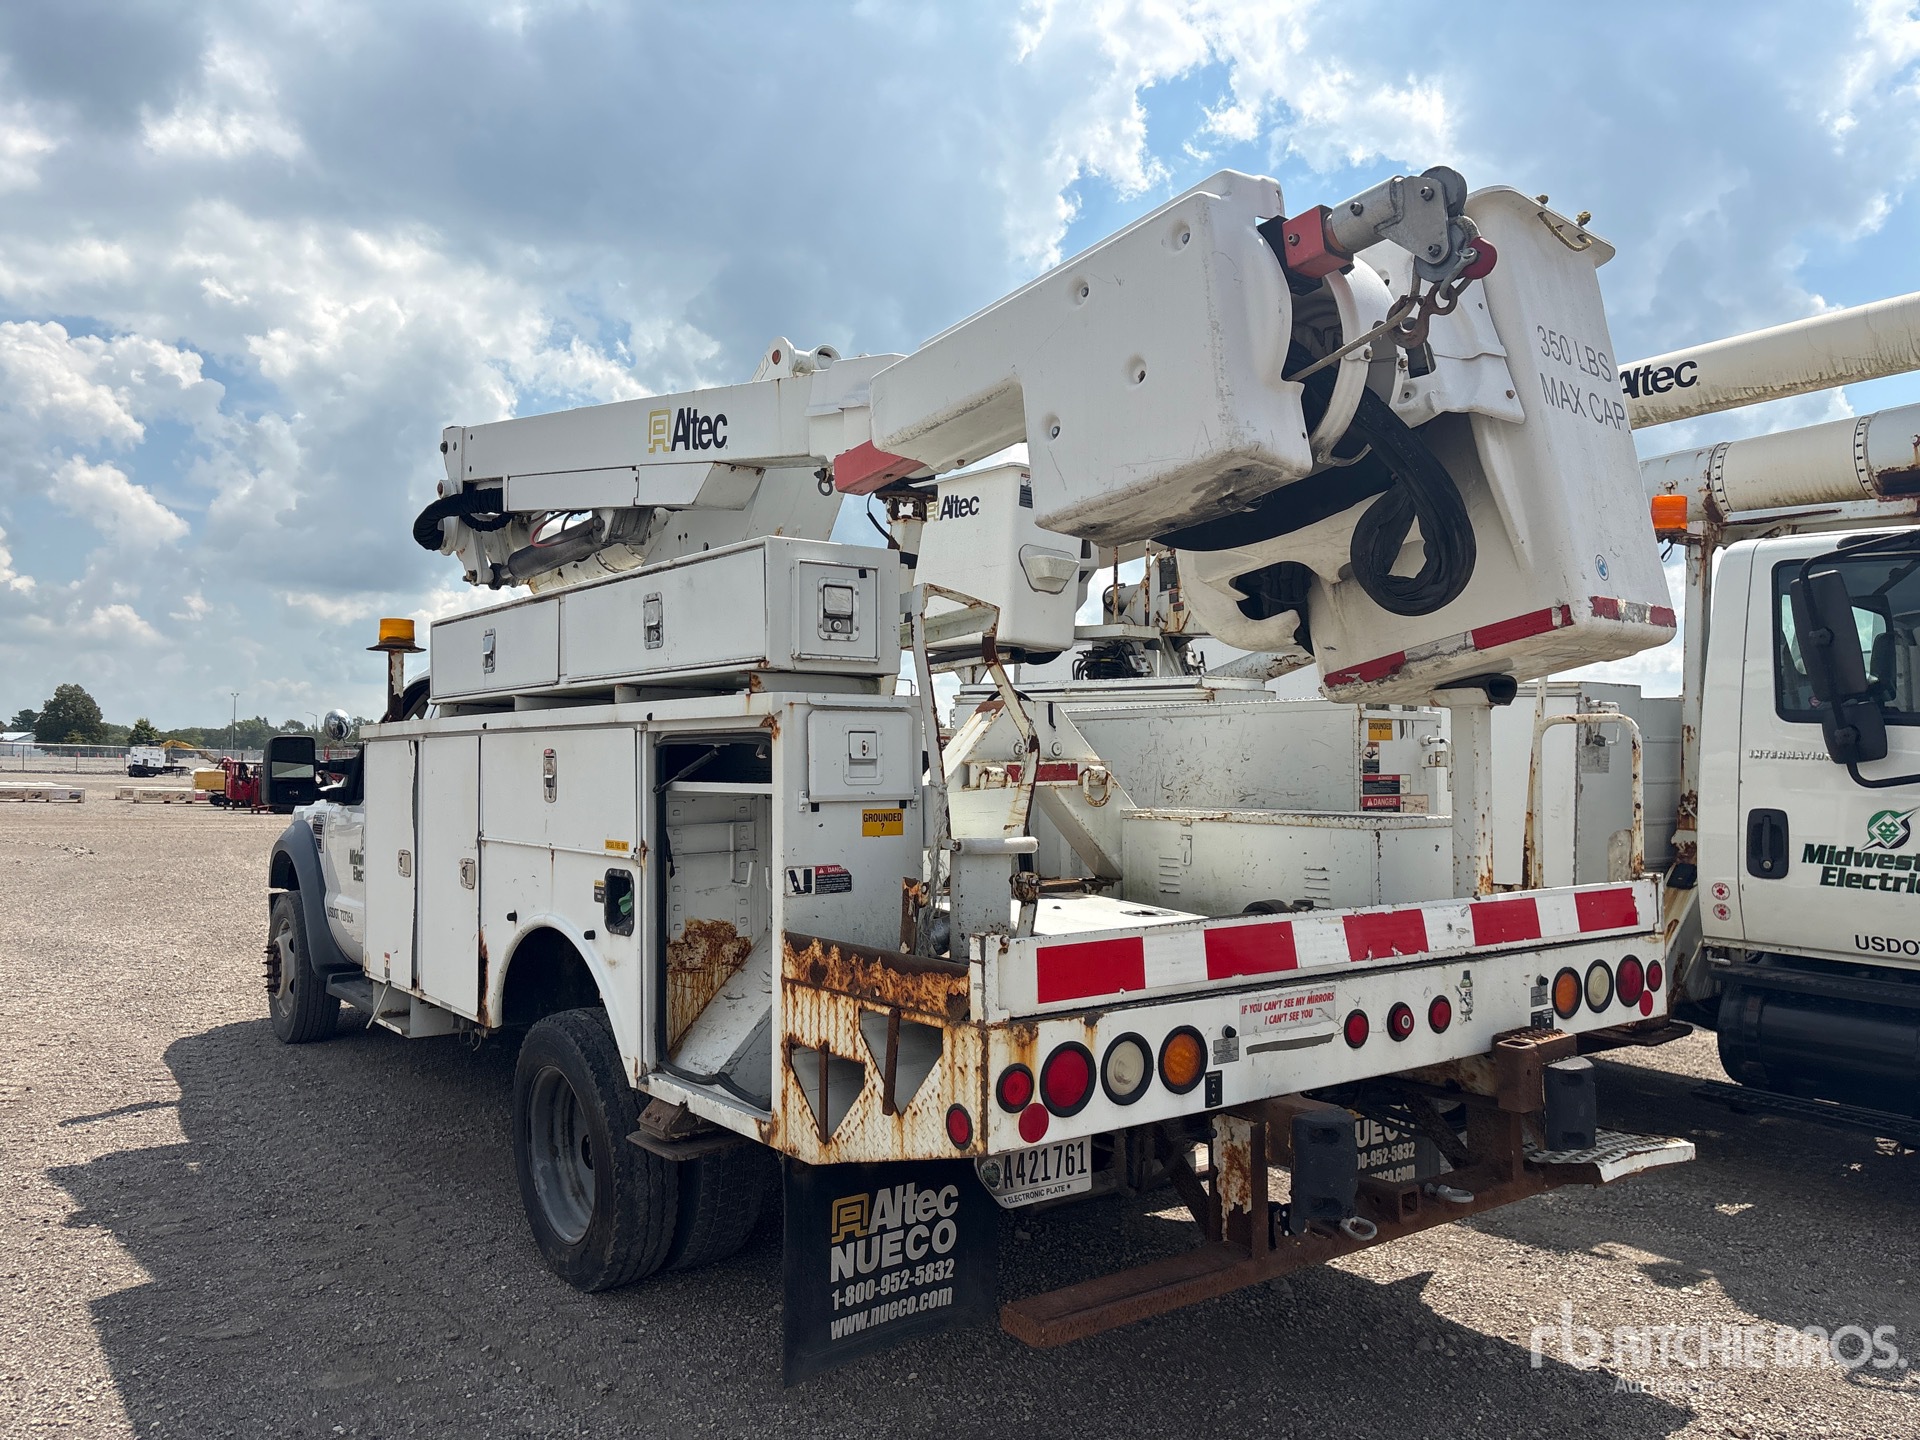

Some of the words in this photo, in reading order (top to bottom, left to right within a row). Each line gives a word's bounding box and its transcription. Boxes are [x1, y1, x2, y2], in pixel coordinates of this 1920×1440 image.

[1537, 325, 1571, 366] 350
[1574, 341, 1611, 382] LBS
[1540, 373, 1587, 418] MAX
[671, 407, 728, 451] Altec
[940, 495, 979, 521] Altec
[1368, 722, 1392, 730] GROUNDED
[1749, 750, 1832, 761] INTERNATION
[1373, 798, 1396, 806] DANGER
[863, 812, 902, 823] GROUNDED
[880, 823, 885, 832] ?
[353, 866, 364, 882] Elec
[1854, 934, 1920, 956] USDO
[1241, 1004, 1247, 1015] IF
[1249, 1003, 1262, 1013] YOU
[1263, 1000, 1282, 1011] CAN'T
[1284, 998, 1295, 1008] SEE
[1295, 996, 1306, 1006] MY
[1307, 992, 1335, 1004] MIRRORS
[1264, 1016, 1268, 1025] I
[1269, 1013, 1287, 1024] CAN'T
[1289, 1011, 1300, 1021] SEE
[1301, 1009, 1313, 1019] YOU
[1004, 1141, 1087, 1189] A421761
[1008, 1190, 1045, 1204] ELECTRONIC
[1046, 1184, 1065, 1197] PLATE
[868, 1182, 959, 1234] Altec
[831, 1219, 957, 1283] NUECO
[832, 1258, 955, 1311] 1-800-952-5832
[831, 1287, 953, 1340] www.nueco.com
